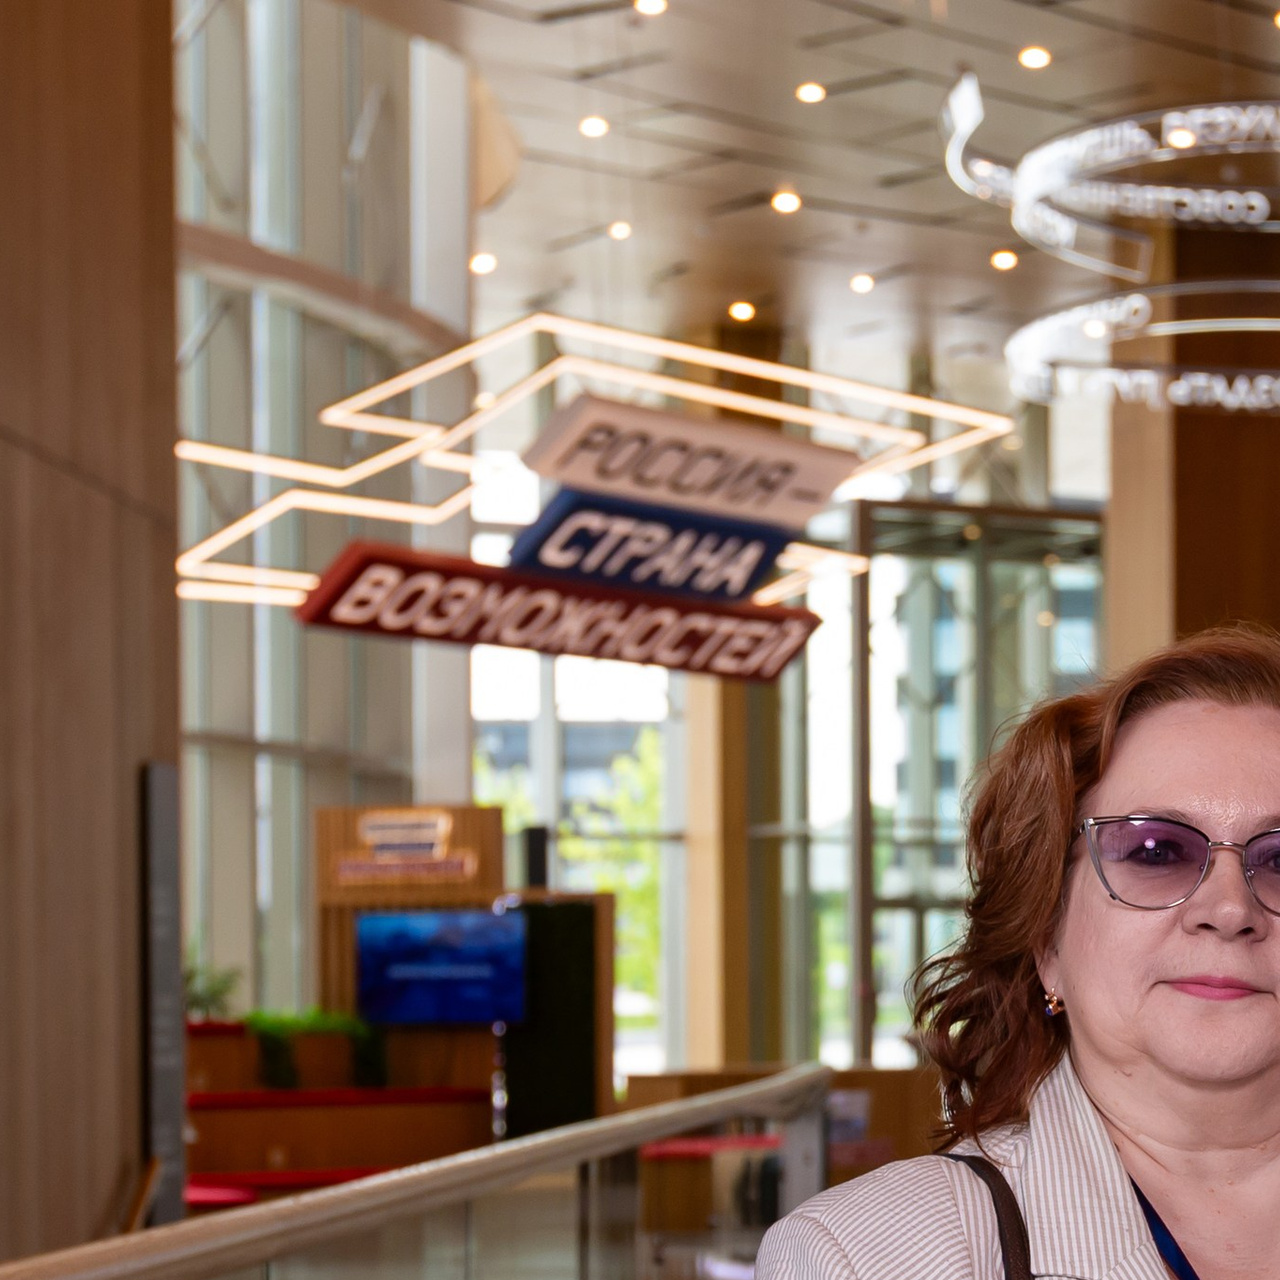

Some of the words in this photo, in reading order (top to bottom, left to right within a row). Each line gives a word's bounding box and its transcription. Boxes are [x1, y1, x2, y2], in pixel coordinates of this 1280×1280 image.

[556, 422, 796, 499] РОССИЯ
[539, 509, 766, 596] СТРАНА
[330, 562, 806, 678] ВОЗМОЖНОСТЕЙ
